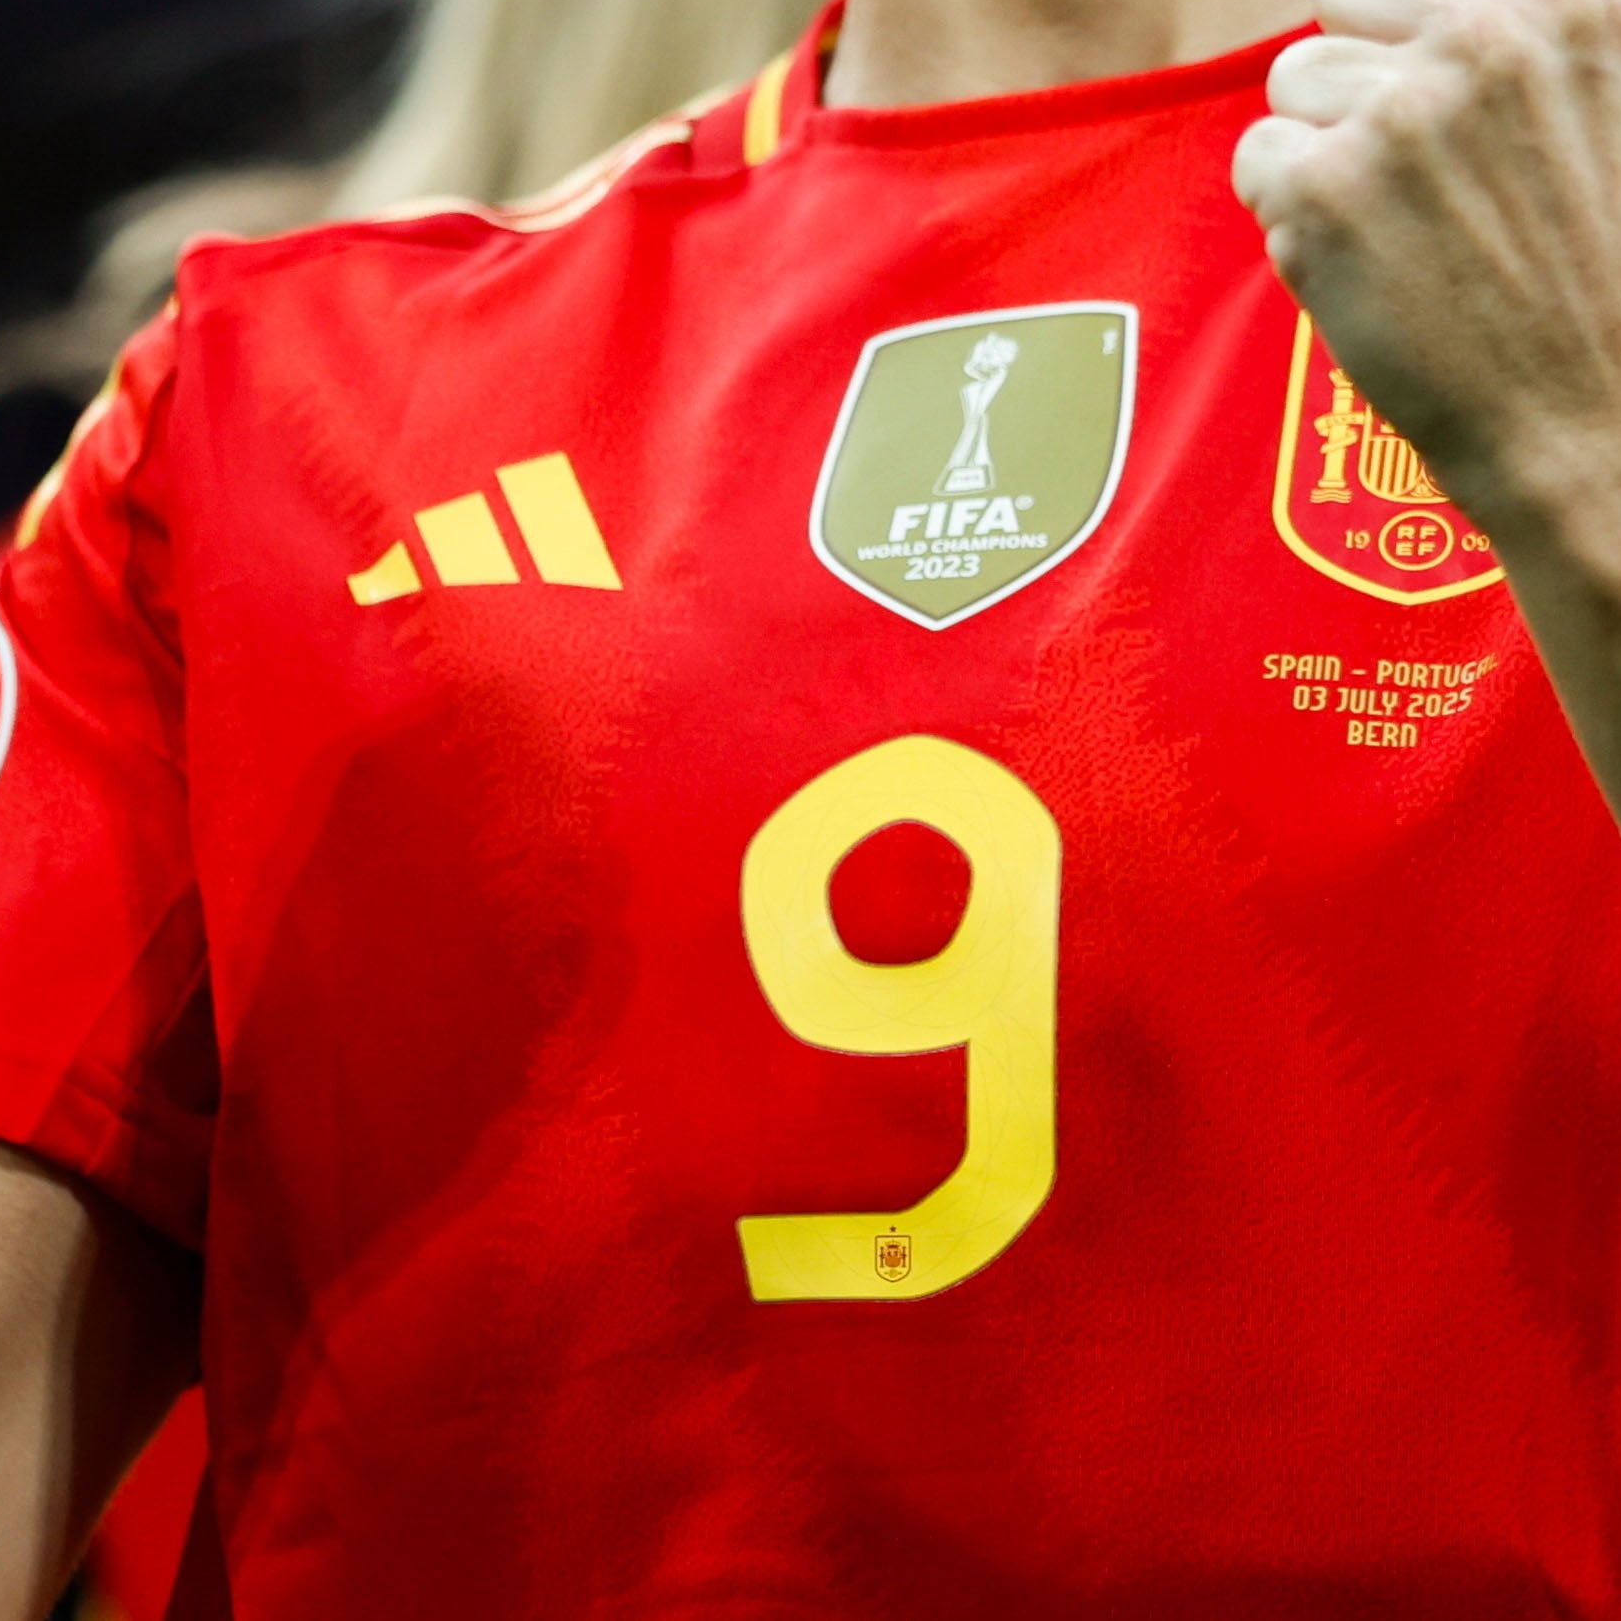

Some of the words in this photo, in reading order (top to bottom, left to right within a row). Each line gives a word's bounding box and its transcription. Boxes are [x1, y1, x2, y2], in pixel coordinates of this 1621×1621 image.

[857, 541, 928, 561] WORLD
[930, 533, 1049, 554] CHAMPIONS
[1345, 530, 1371, 549] 19
[904, 553, 982, 581] 2023
[1262, 654, 1341, 682] SPAIN
[1292, 685, 1327, 711] 03
[1335, 687, 1399, 716] JULY
[1406, 687, 1475, 718] 2025
[1346, 720, 1418, 748] BERN
[735, 733, 1063, 1304] 9
